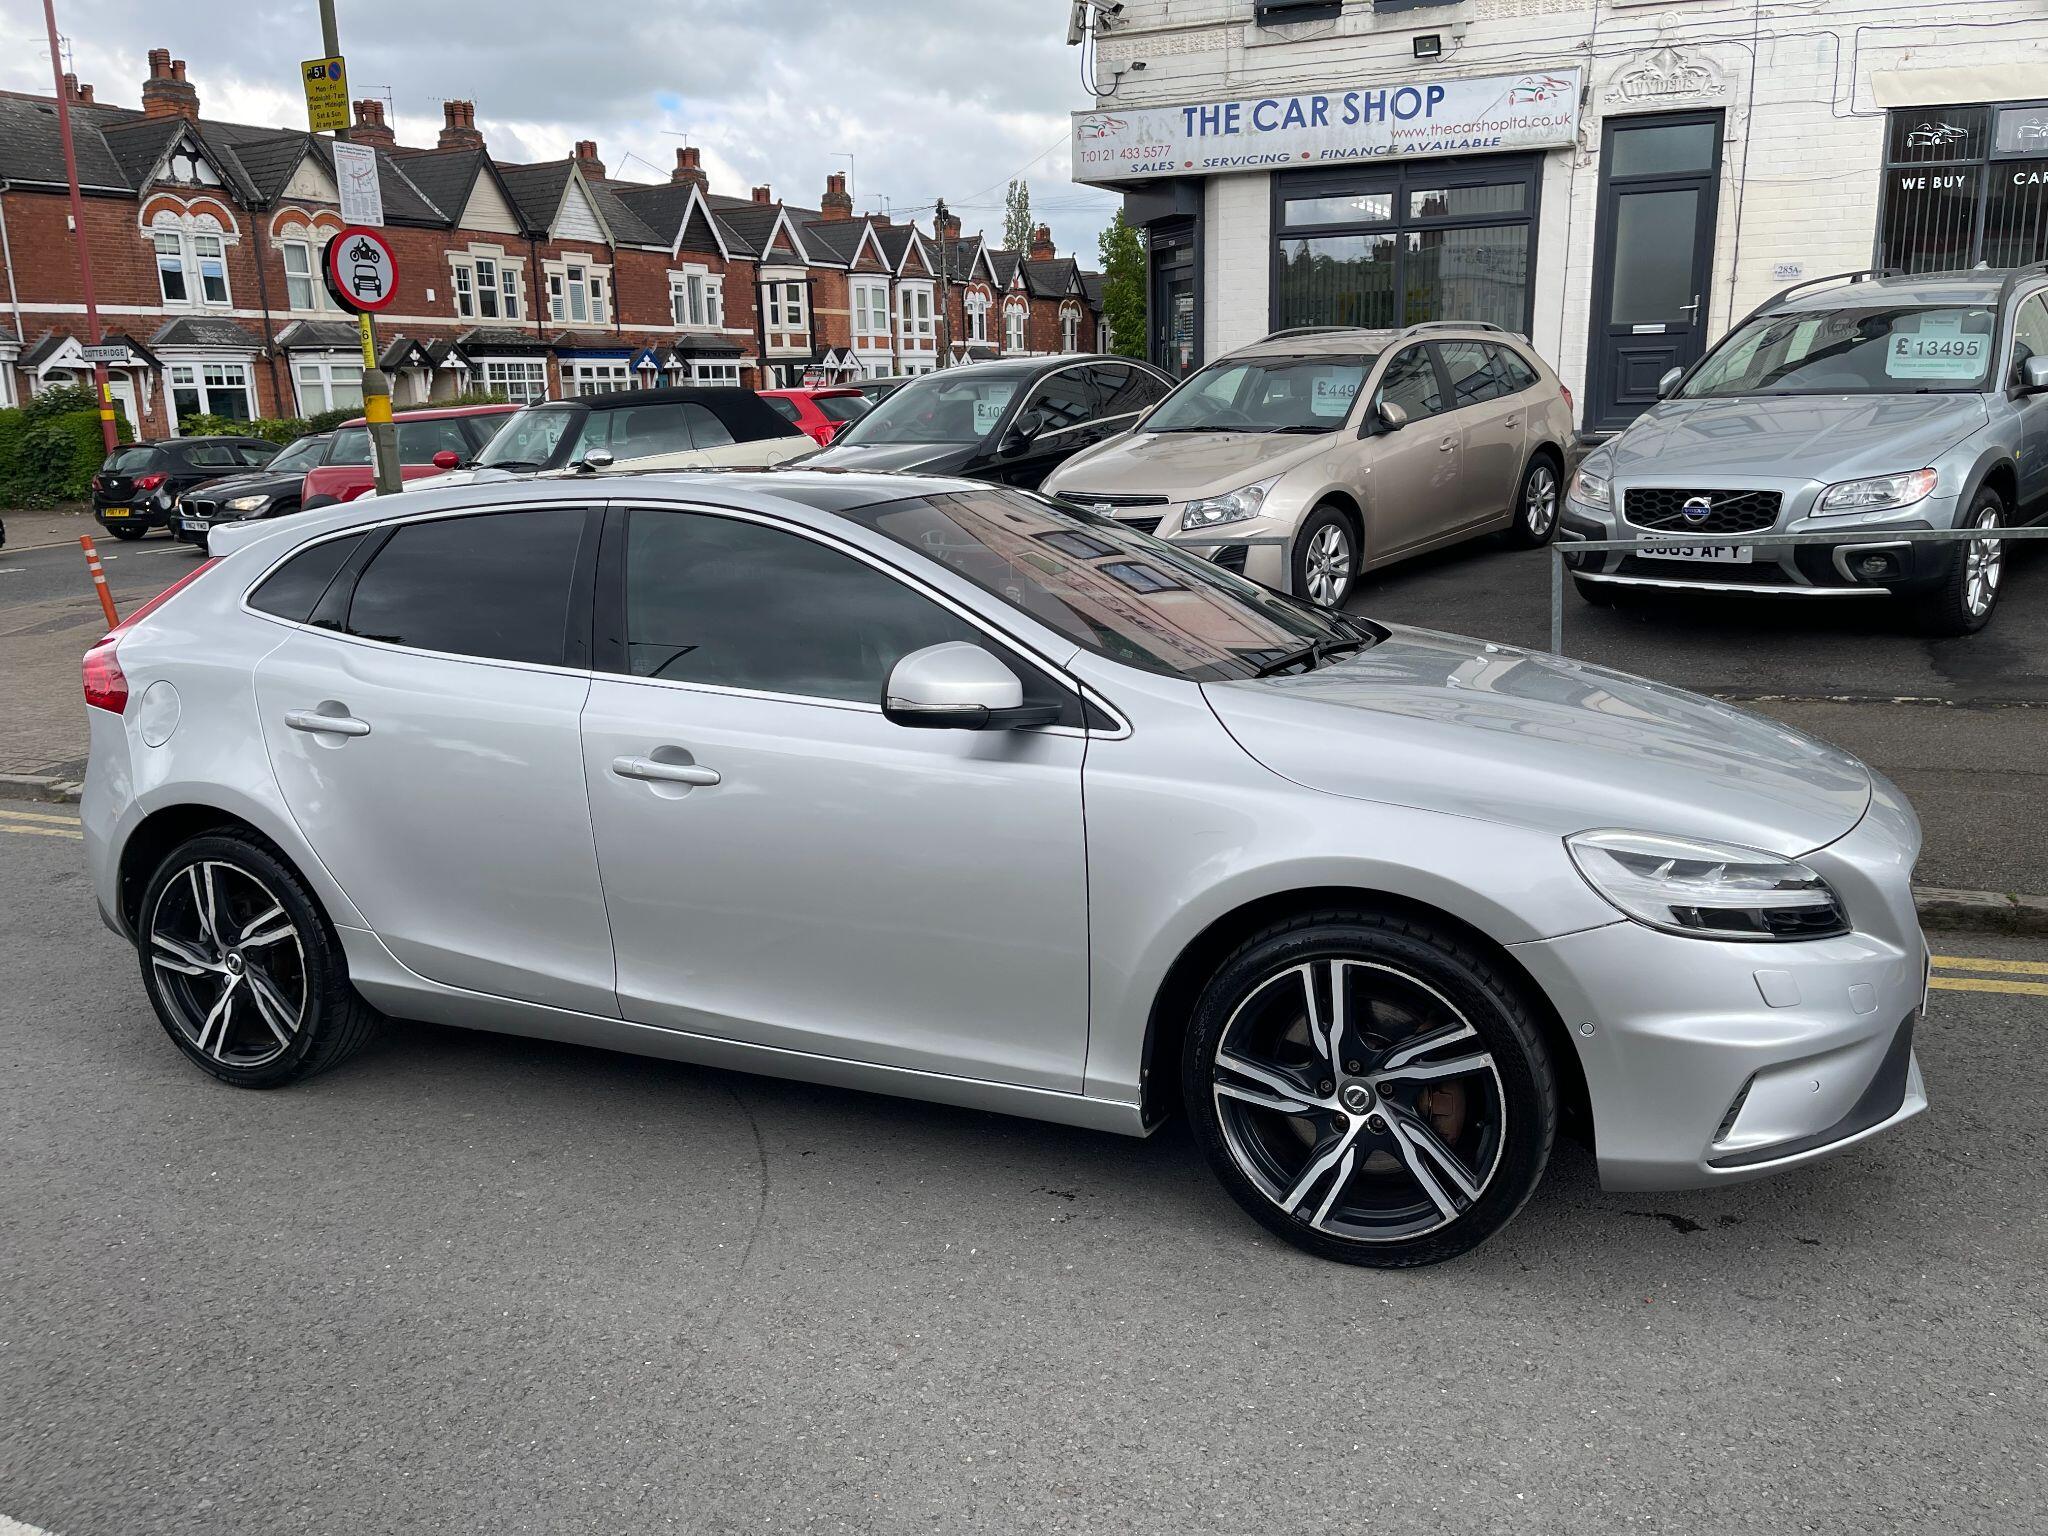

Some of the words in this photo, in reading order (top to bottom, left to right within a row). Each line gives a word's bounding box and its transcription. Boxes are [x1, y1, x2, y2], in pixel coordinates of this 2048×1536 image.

[1182, 103, 1241, 138] THE
[1252, 95, 1329, 132] CAR
[1341, 85, 1445, 125] SHOP
[1390, 112, 1572, 138] www.thecarshopltd.co.uk
[1080, 149, 1115, 163] T:0121
[1119, 147, 1140, 160] 433
[1143, 144, 1172, 159] 5577
[1130, 161, 1175, 173] SALES
[1202, 152, 1291, 168] SERVICING
[1320, 144, 1399, 160] FINANCE
[1403, 136, 1502, 153] AVAILABLE
[1902, 177, 1926, 190] WE
[1933, 175, 1966, 189] BUY
[84, 348, 125, 358] COTTERIDGE
